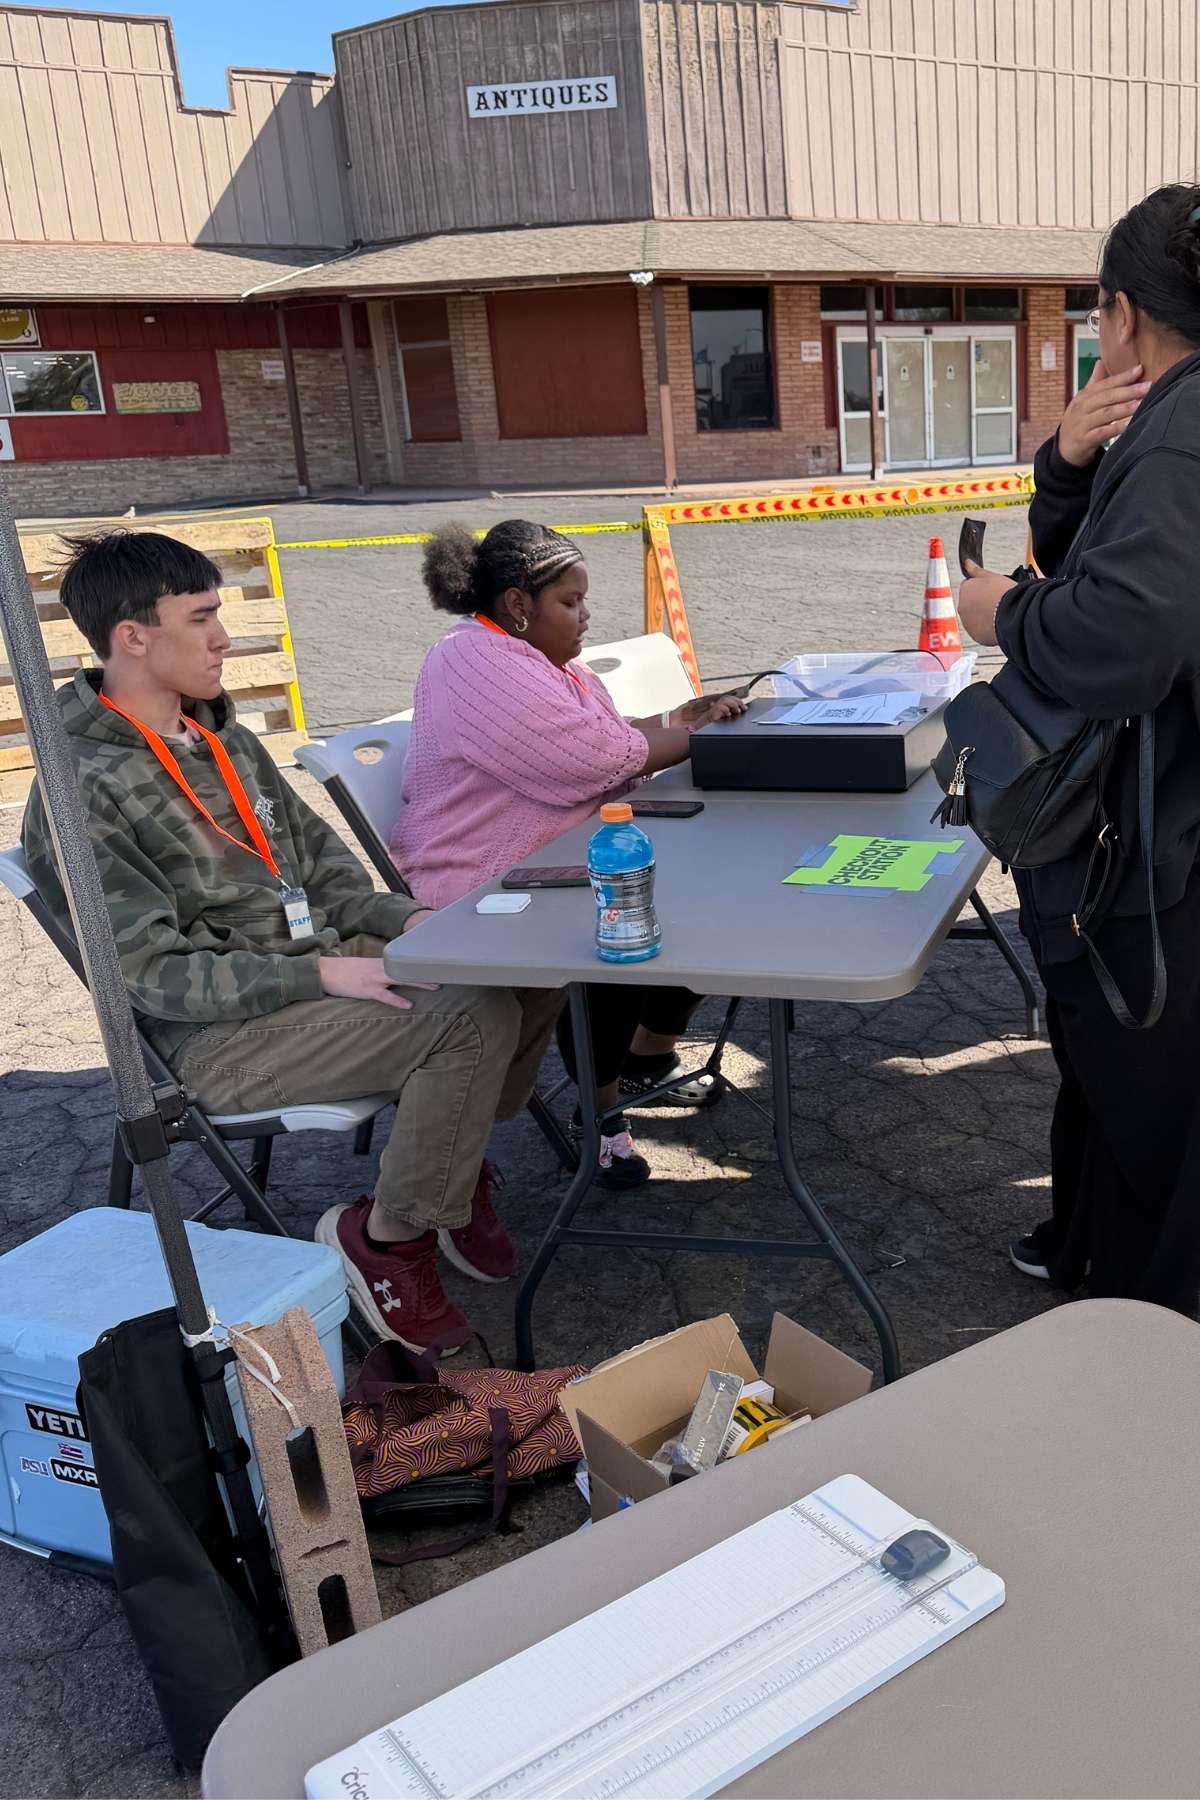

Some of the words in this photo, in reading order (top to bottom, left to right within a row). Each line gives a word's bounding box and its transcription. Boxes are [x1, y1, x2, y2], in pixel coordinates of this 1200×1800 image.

[475, 83, 608, 110] ANTIQUES
[827, 839, 893, 885] CHECKOUT
[856, 845, 911, 881] STATION
[289, 916, 312, 928] STAFF
[28, 1408, 85, 1439] YETI
[341, 1766, 370, 1800] Cric
